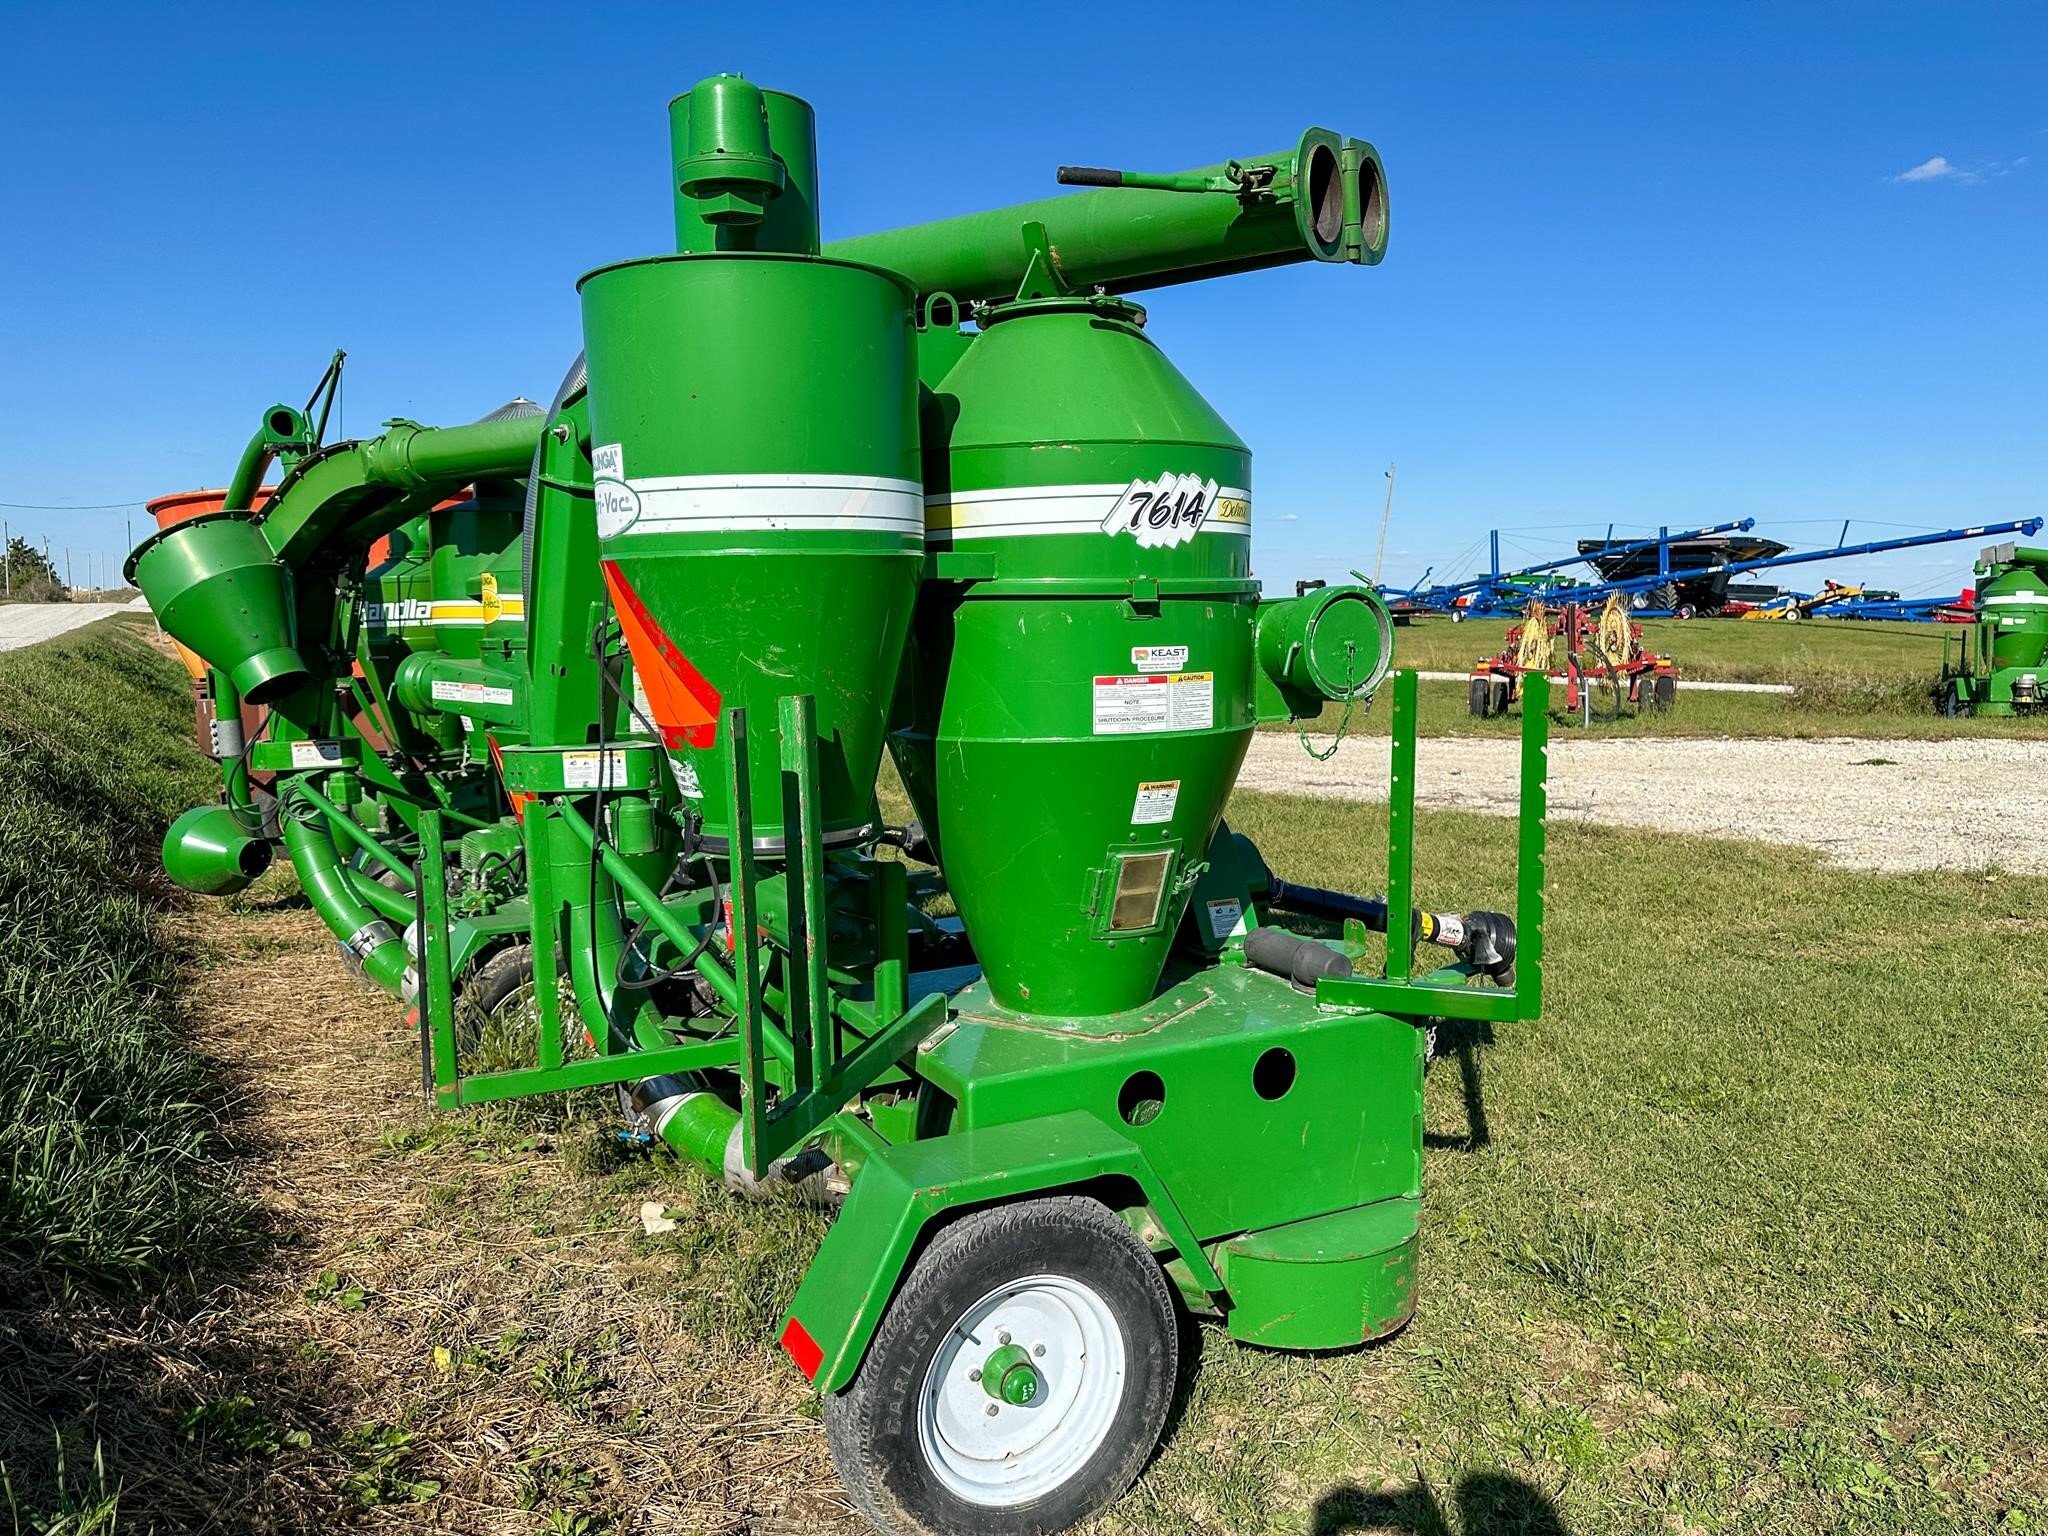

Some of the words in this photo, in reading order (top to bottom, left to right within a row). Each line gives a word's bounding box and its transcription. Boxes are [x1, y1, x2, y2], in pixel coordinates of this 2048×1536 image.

[1128, 490, 1206, 530] 7614
[1151, 648, 1186, 657] KEAST
[1183, 674, 1205, 682] CAUTION
[884, 1292, 954, 1435] CARLISLE
